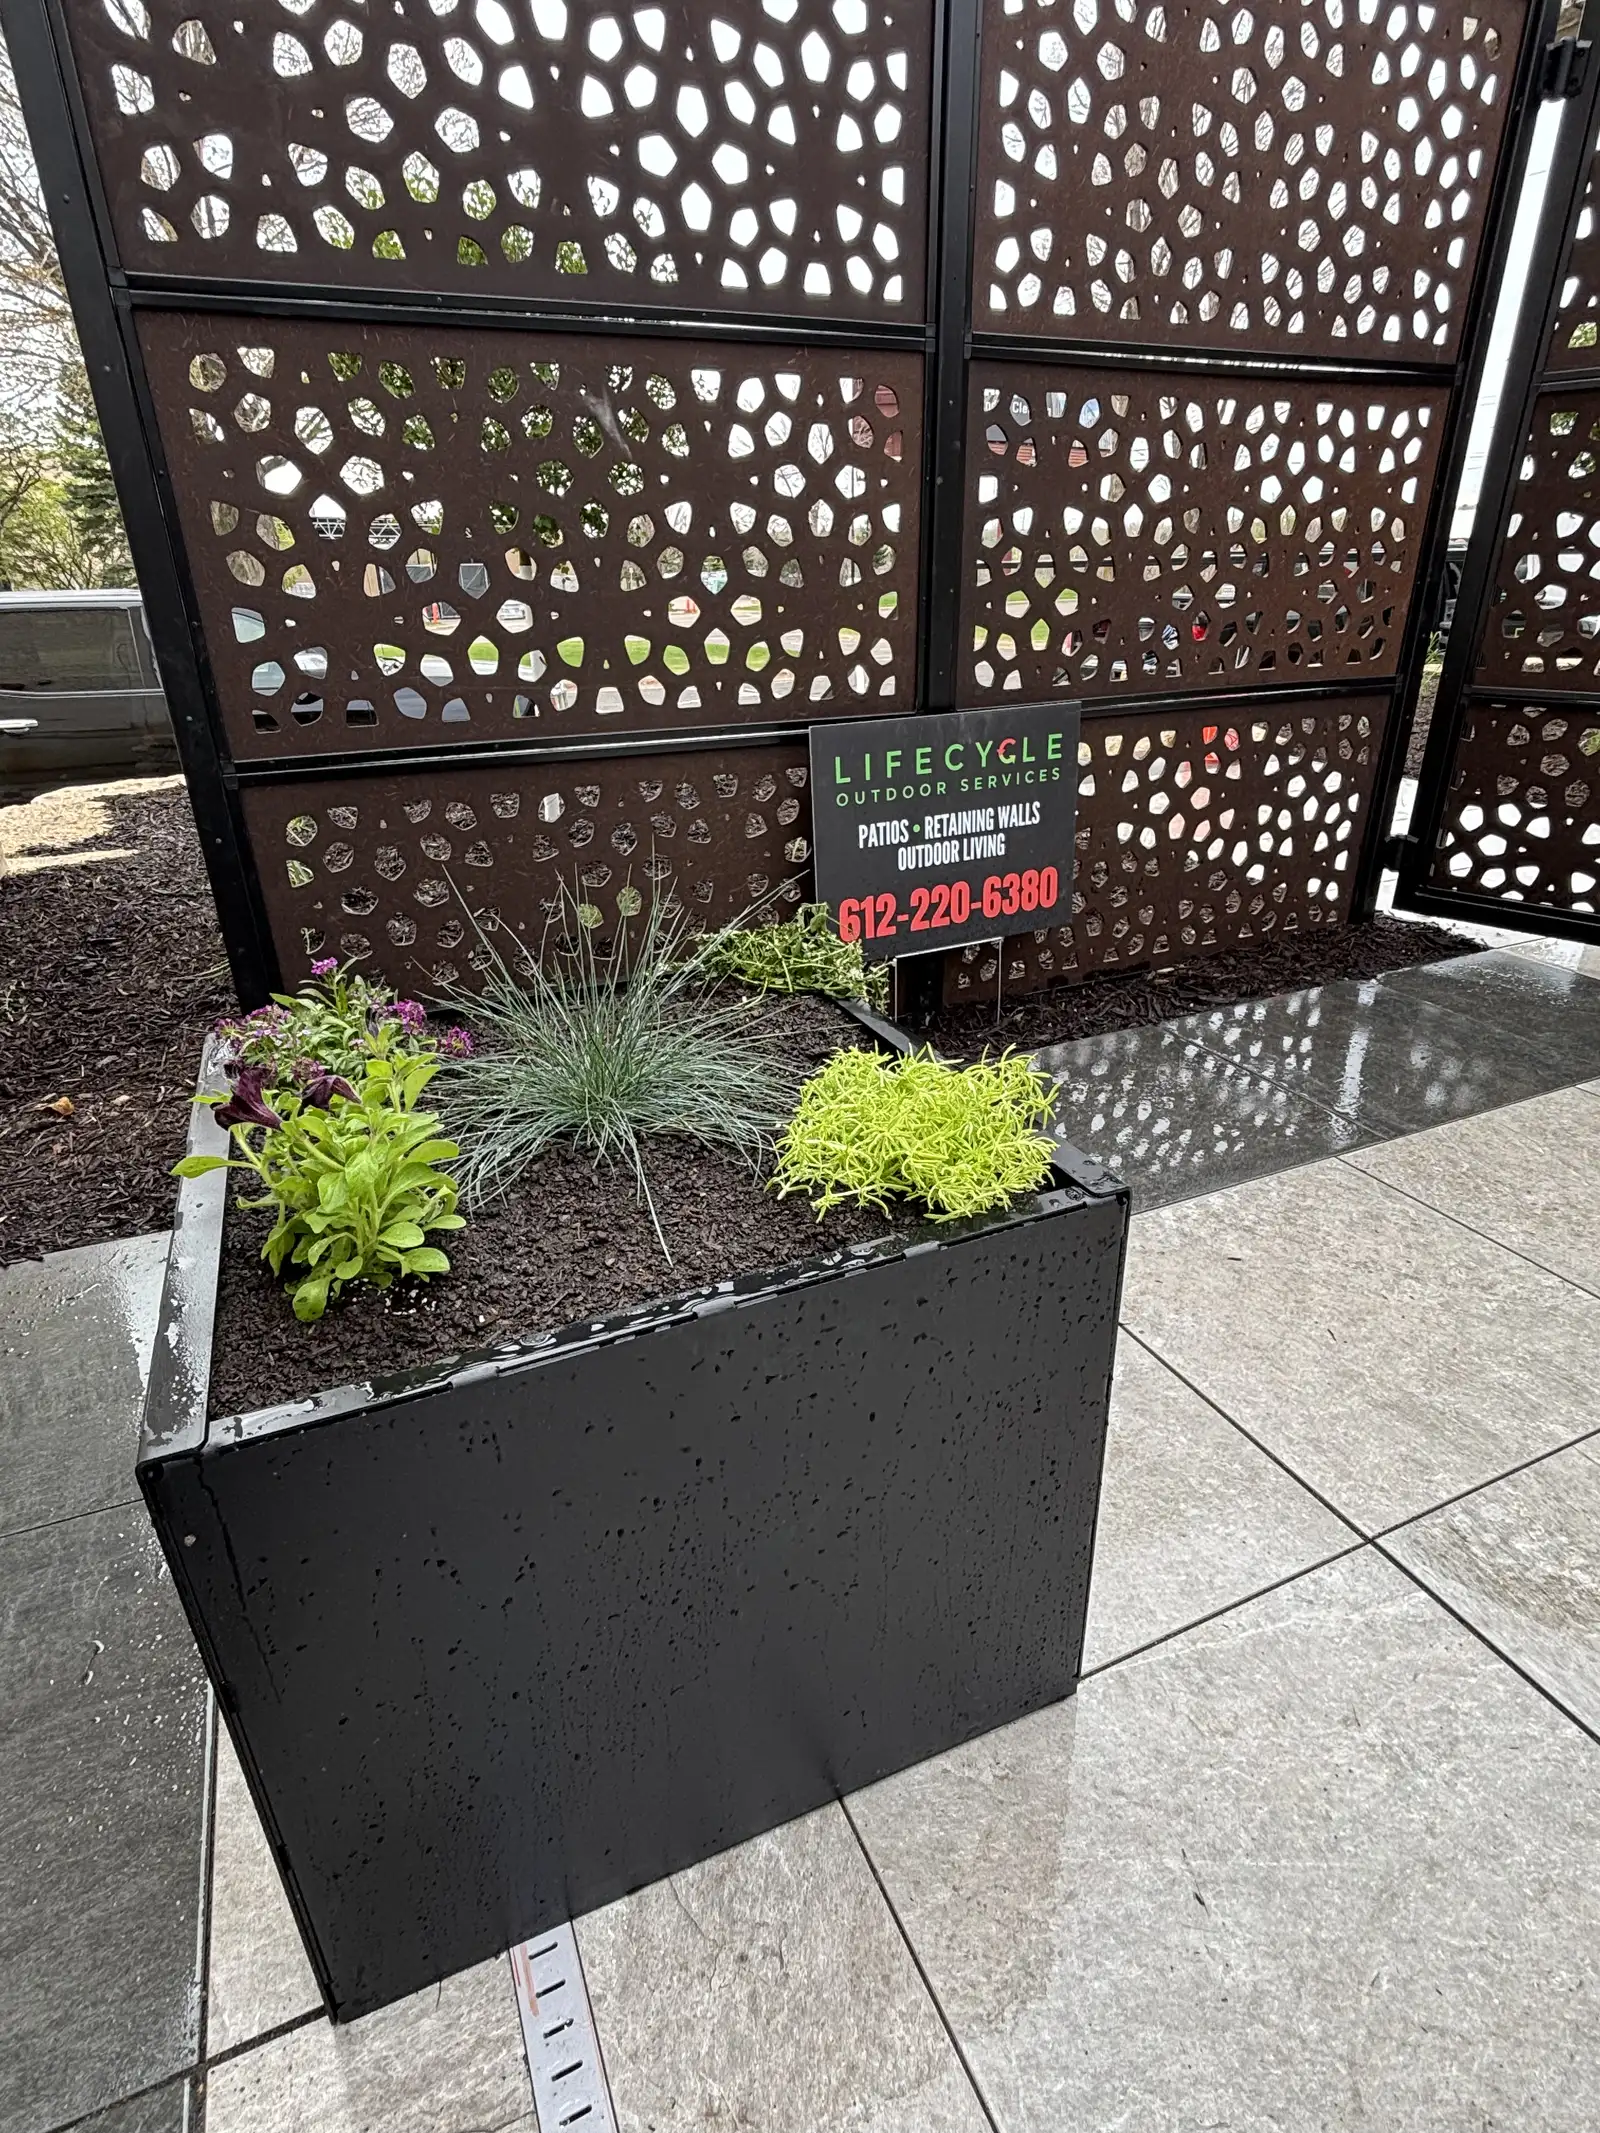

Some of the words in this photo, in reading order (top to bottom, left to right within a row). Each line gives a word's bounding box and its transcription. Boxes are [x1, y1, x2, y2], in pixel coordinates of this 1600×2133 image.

[834, 733, 1063, 784] LIFECYCLE
[836, 782, 946, 807] OUTDOOR
[960, 768, 1060, 792] SERVICES
[858, 819, 909, 849] PATIOS
[924, 809, 994, 840] RETAINING
[997, 801, 1041, 829] WALLS
[897, 843, 959, 871] OUTDOOR
[963, 833, 1006, 860] LIVING
[839, 866, 1059, 943] 612-220-6380
